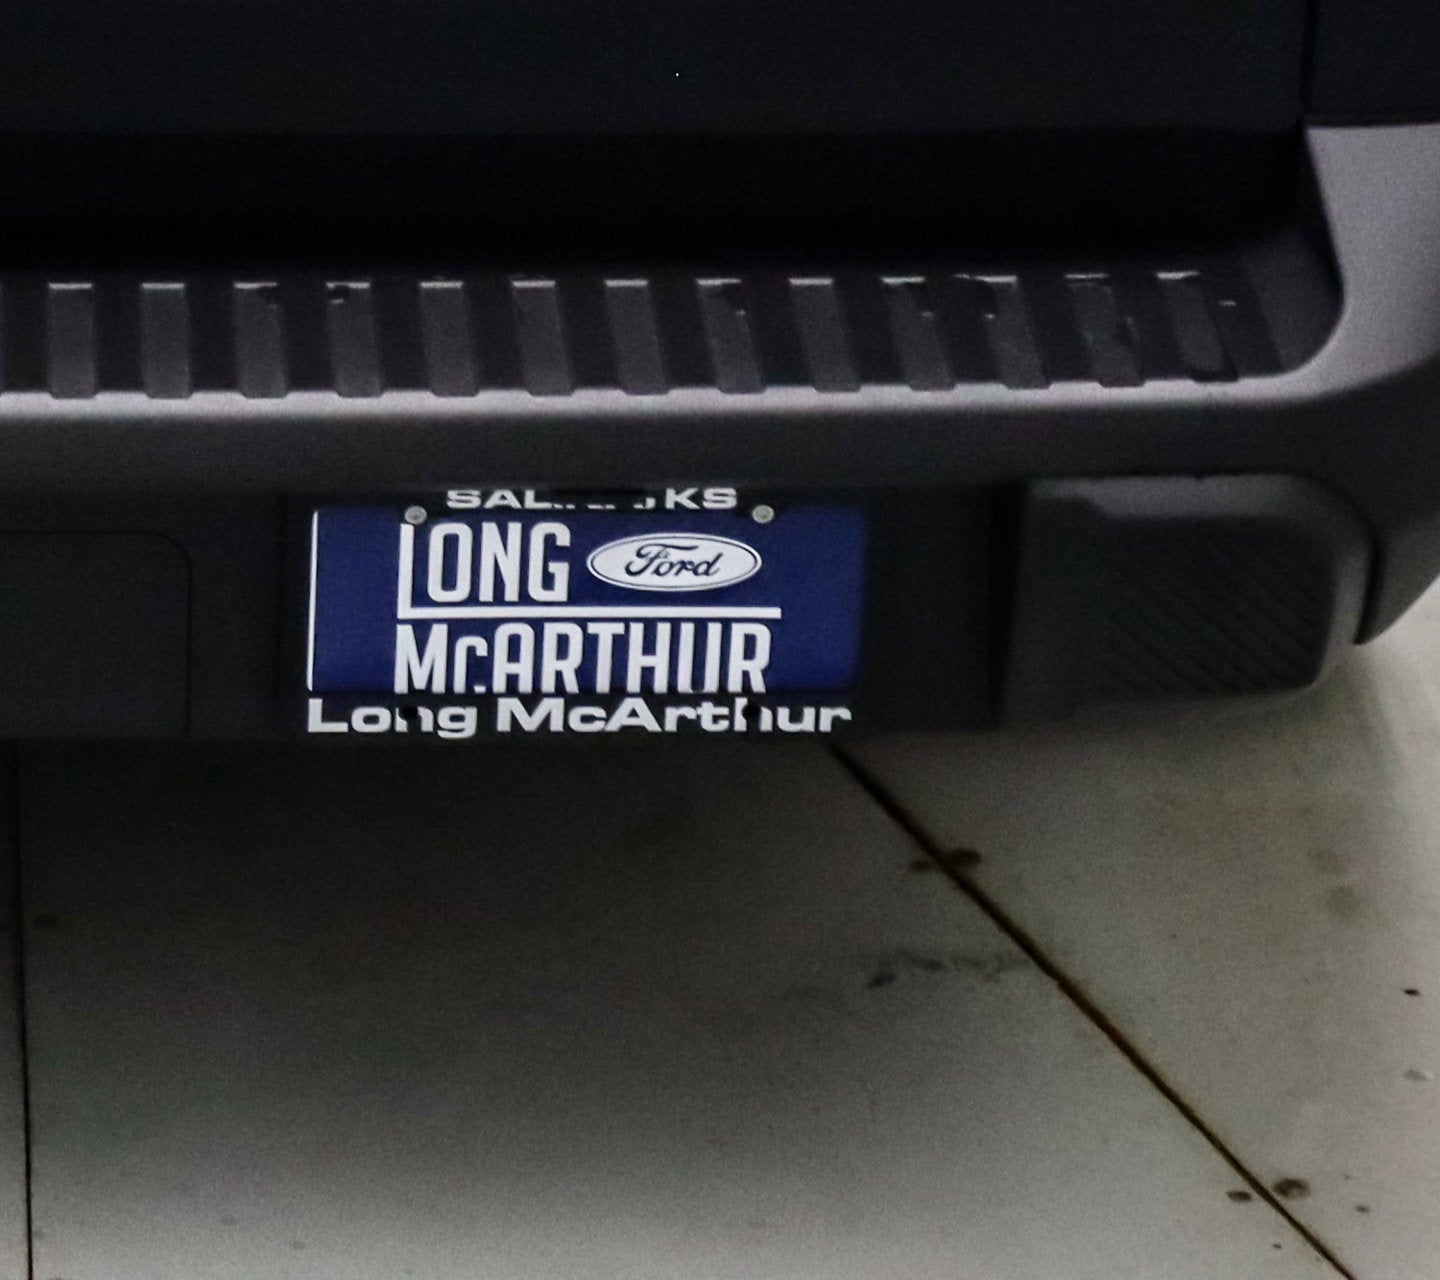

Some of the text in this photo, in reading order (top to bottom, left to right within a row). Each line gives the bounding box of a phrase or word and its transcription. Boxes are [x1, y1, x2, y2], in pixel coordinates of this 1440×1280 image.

[665, 488, 737, 509] KS
[397, 521, 571, 618] LONG
[625, 543, 723, 577] Ford
[394, 622, 771, 694] McARTHUR
[307, 696, 853, 739] Long McArthur
